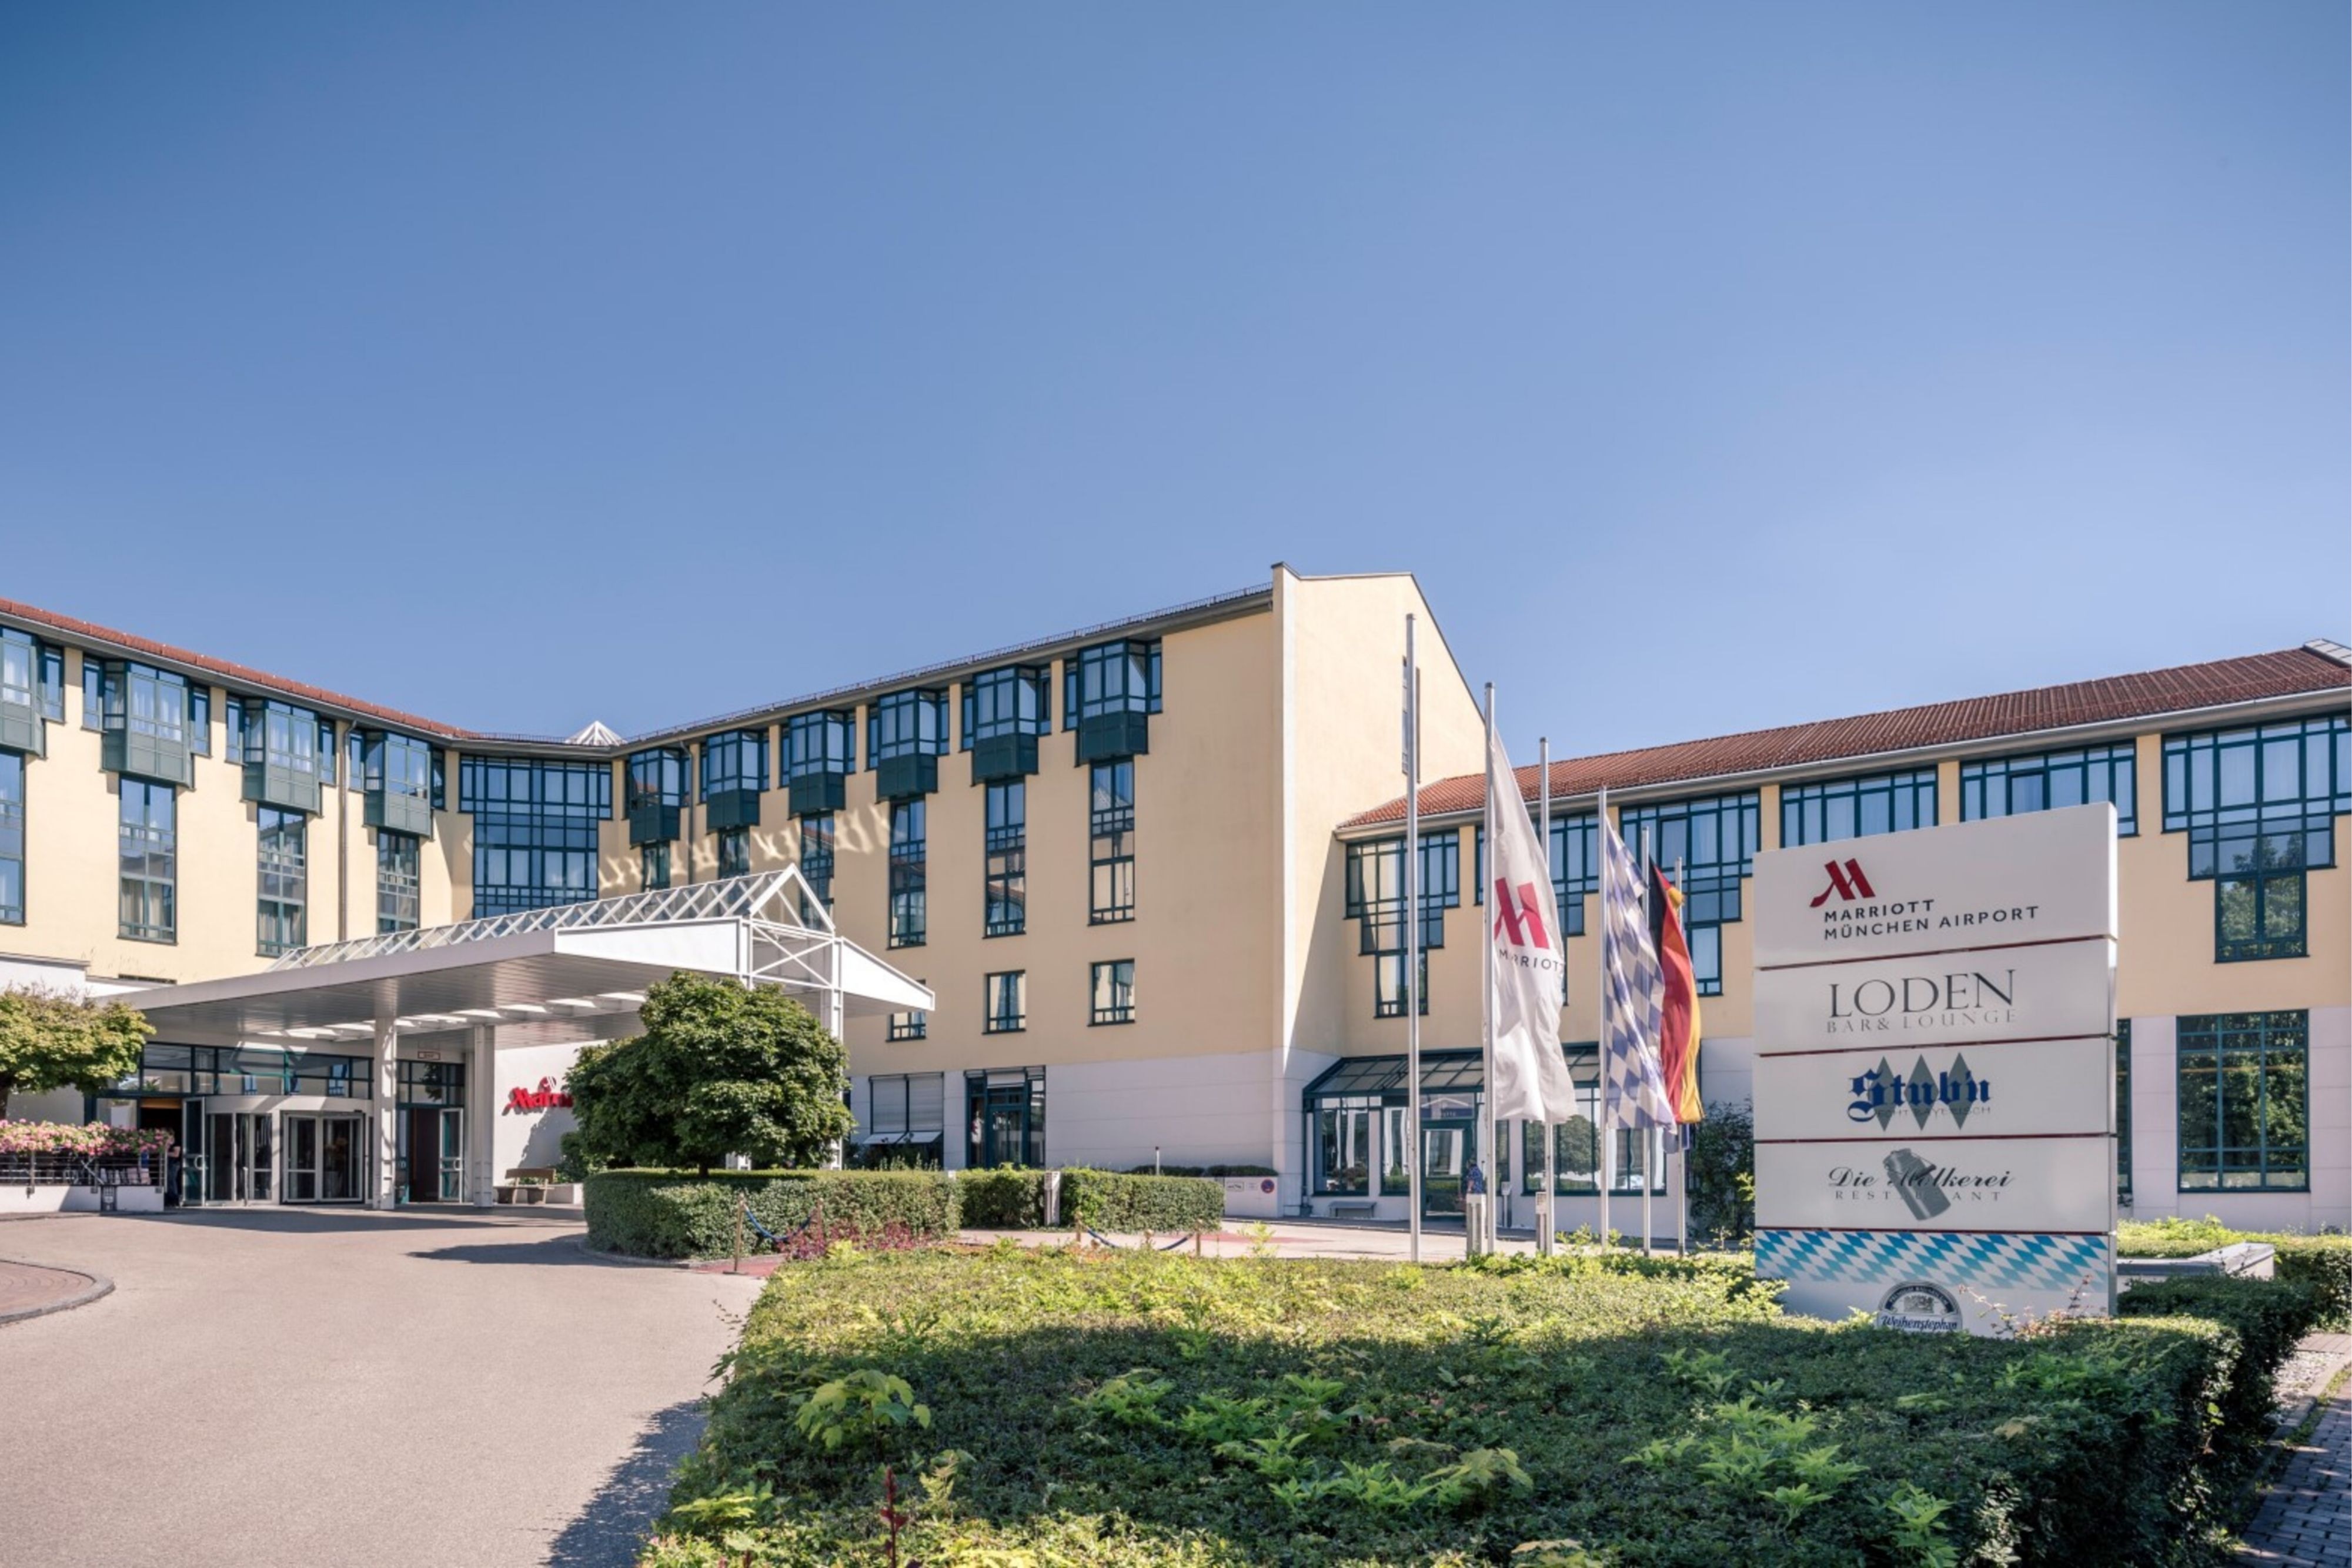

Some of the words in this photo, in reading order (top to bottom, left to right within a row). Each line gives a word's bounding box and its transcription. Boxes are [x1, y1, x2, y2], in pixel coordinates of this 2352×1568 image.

[1824, 899, 1935, 922] MARRIOTT
[1824, 918, 1929, 940] MÜNCHEN
[1939, 906, 2039, 928] AIRPORT
[1499, 948, 1565, 972] MRRIOT
[1828, 969, 2016, 1018] LODEN
[1903, 1009, 2018, 1029] LOUNGE
[1828, 1166, 1877, 1188] Die
[1835, 1191, 2001, 1201] RESTUANT
